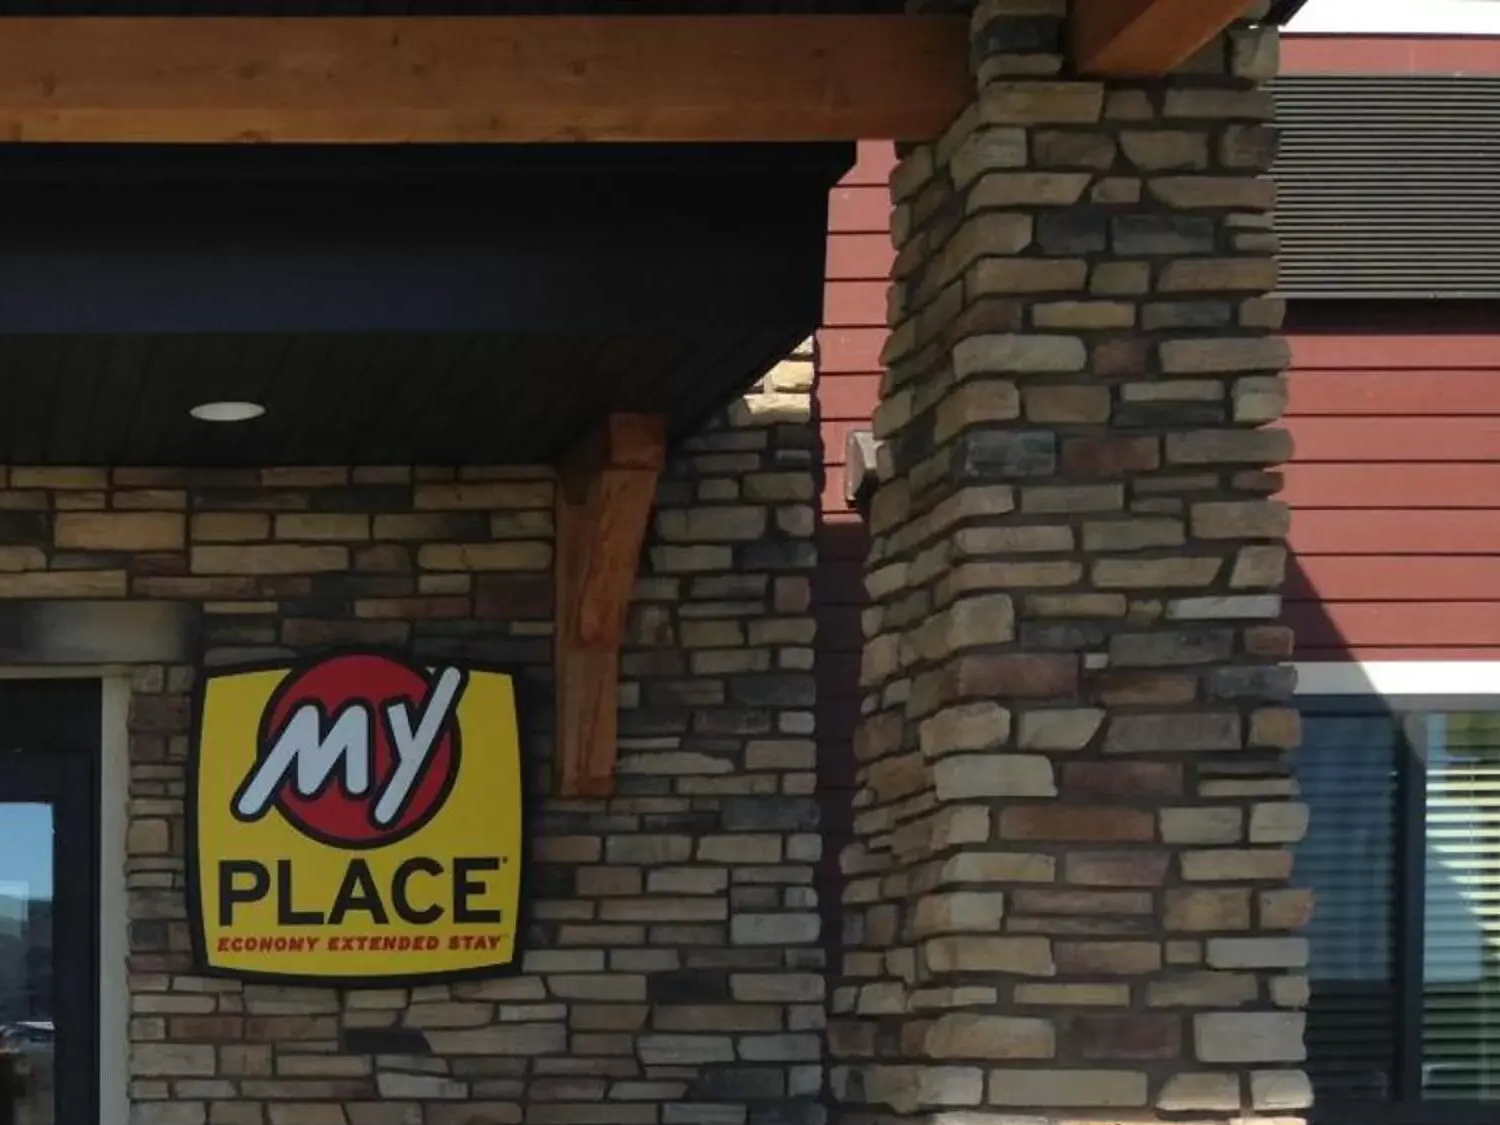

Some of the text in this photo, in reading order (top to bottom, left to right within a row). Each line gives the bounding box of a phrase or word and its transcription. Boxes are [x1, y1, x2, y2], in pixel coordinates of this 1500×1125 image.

[218, 856, 502, 927] PLACE
[217, 934, 501, 952] ECONOMY EXTENDED STAY
